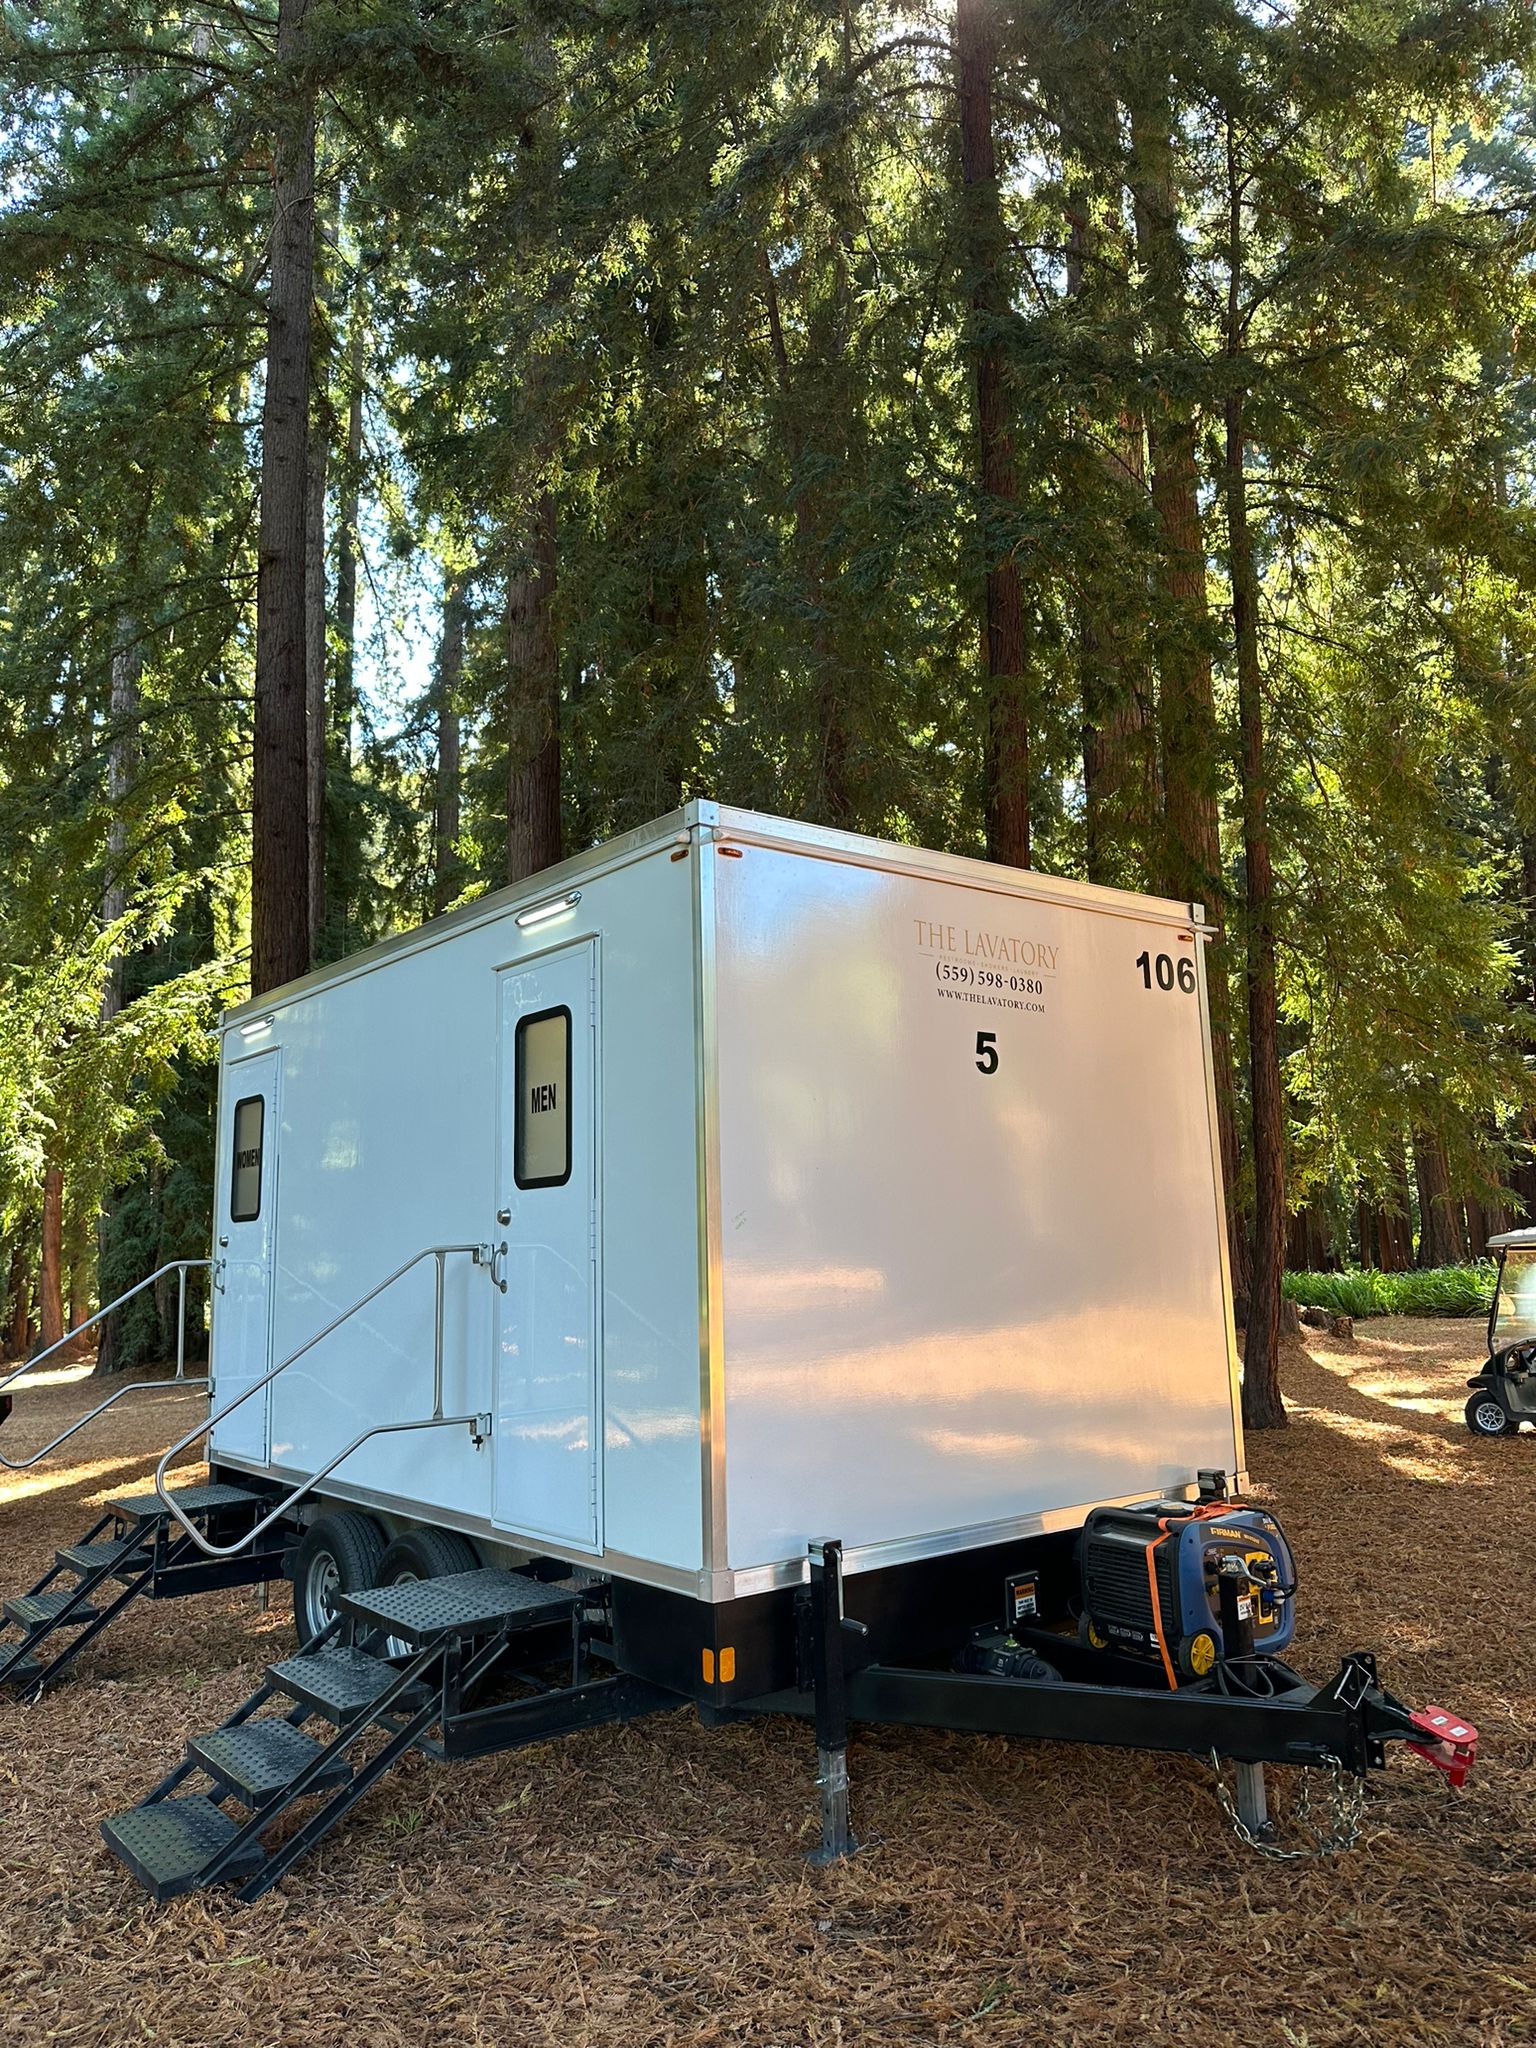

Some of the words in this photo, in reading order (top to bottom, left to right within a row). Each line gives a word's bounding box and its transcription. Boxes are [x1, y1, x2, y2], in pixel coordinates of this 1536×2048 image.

[914, 919, 956, 951] THE
[965, 929, 1059, 969] LAVATORY
[935, 961, 974, 986] (559)
[977, 971, 1043, 995] 598-0380
[1136, 951, 1196, 994] 106
[937, 988, 1045, 1013] WWW.THELAVATORY.COM
[975, 1031, 999, 1075] 5
[532, 1083, 556, 1114] MEN
[236, 1148, 261, 1170] WOMEN
[1210, 1527, 1242, 1539] FIRMAN
